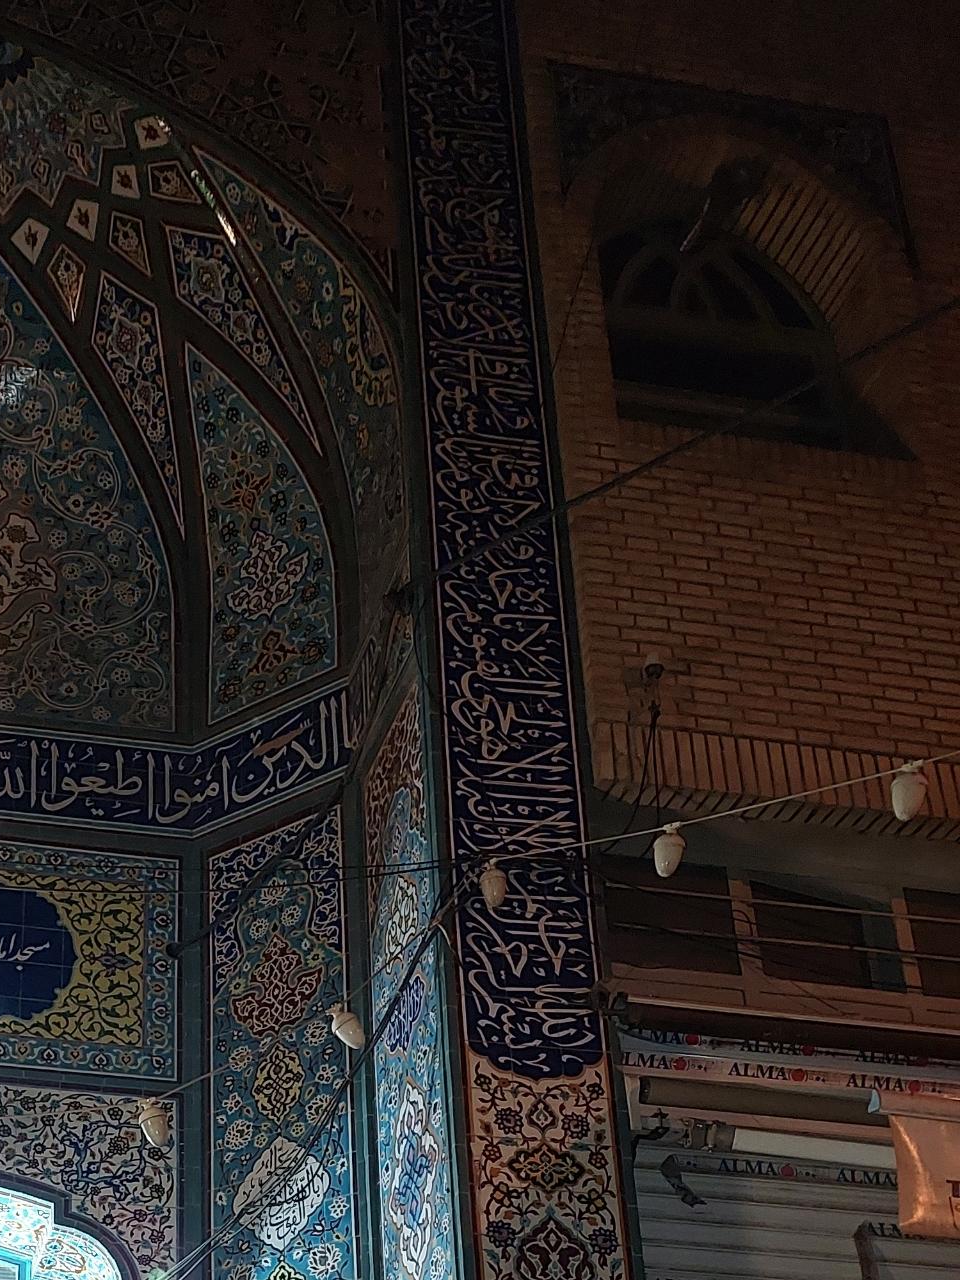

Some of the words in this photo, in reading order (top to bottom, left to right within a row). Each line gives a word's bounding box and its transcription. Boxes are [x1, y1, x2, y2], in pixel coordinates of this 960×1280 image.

[13, 942, 51, 971] مسجد
[623, 1051, 671, 1069] LMA
[728, 1062, 789, 1082] ALMA
[846, 1073, 908, 1092] ALMA
[718, 1157, 777, 1176] ALMA
[836, 1168, 897, 1187] ALMA
